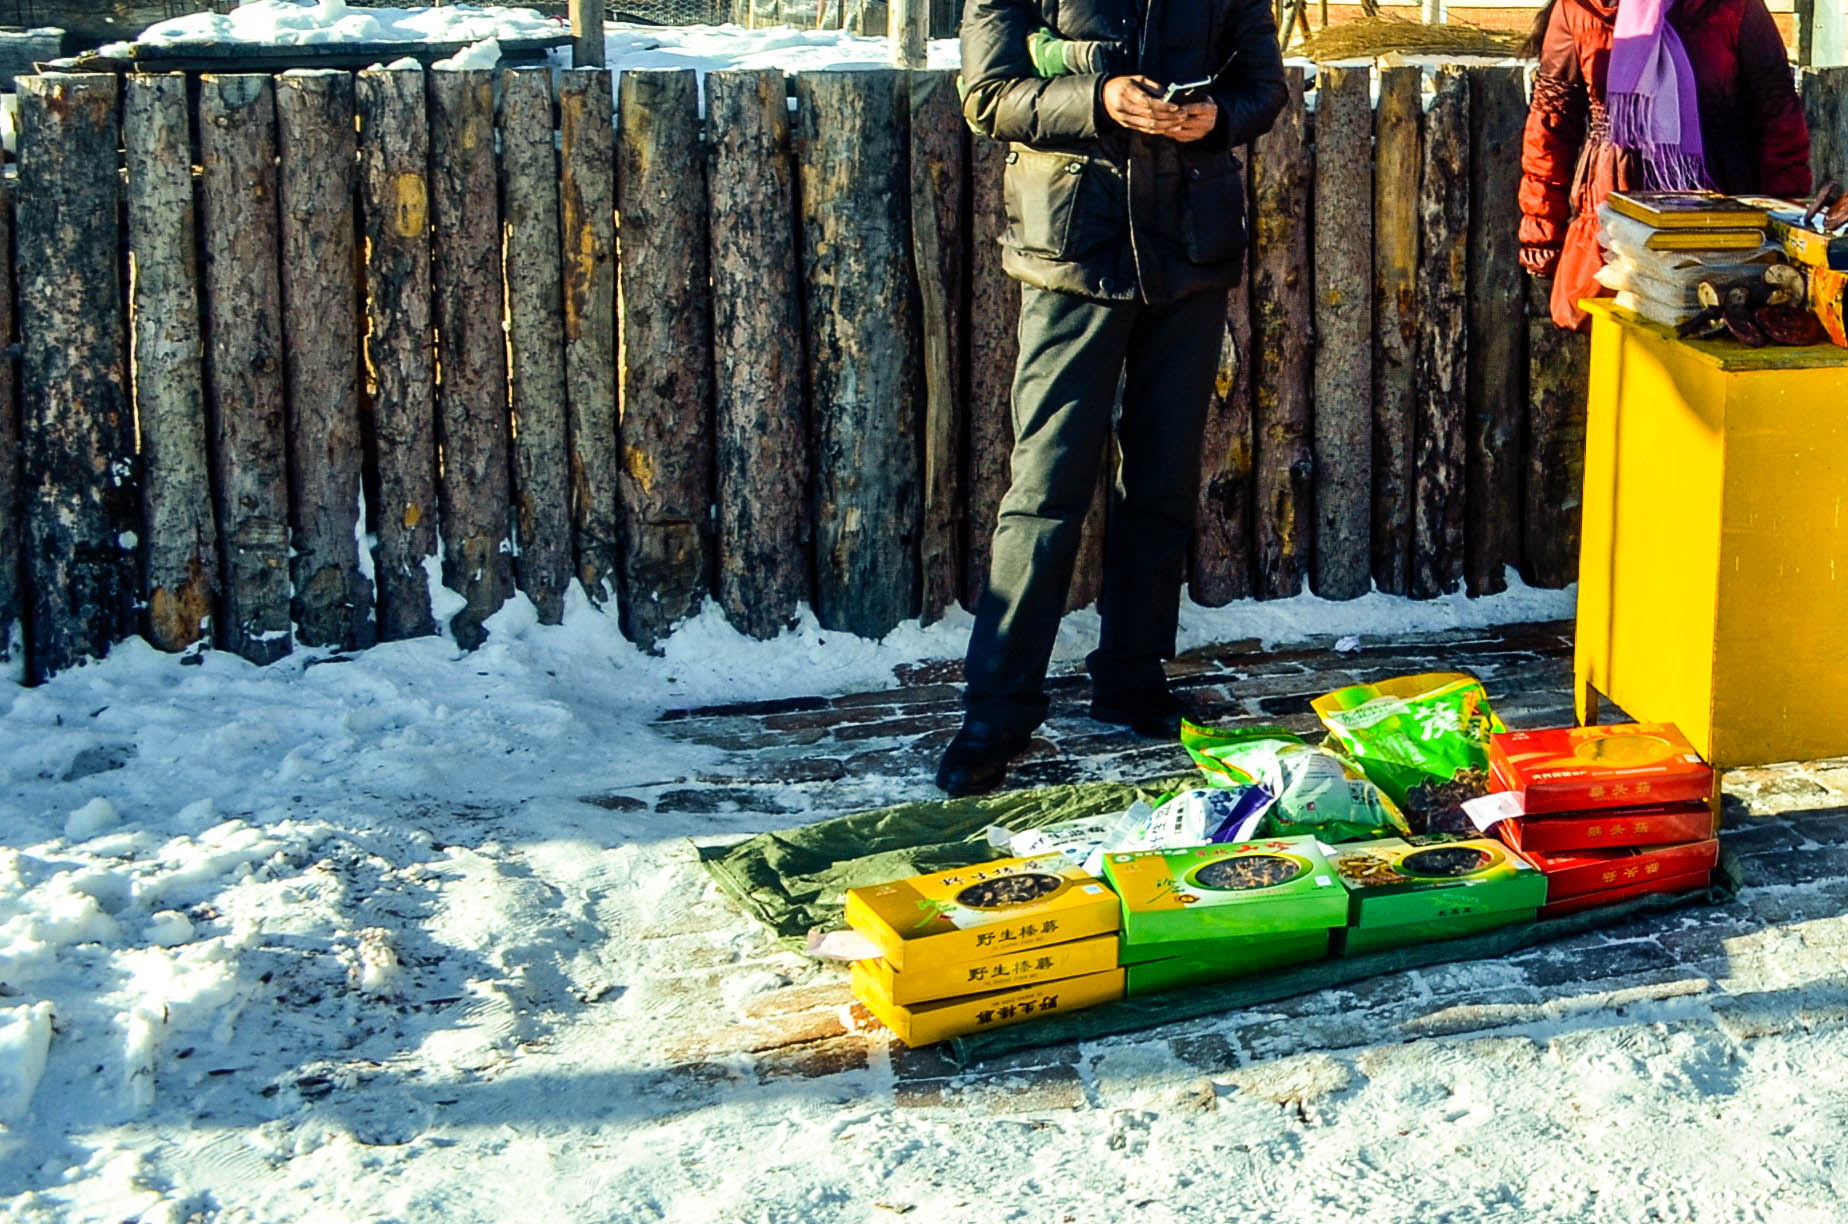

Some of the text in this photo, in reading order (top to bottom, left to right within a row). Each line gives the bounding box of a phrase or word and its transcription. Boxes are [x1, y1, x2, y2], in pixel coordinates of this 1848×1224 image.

[976, 919, 1059, 948] 野生榛蘑
[968, 956, 1054, 982] 野生榛蘑
